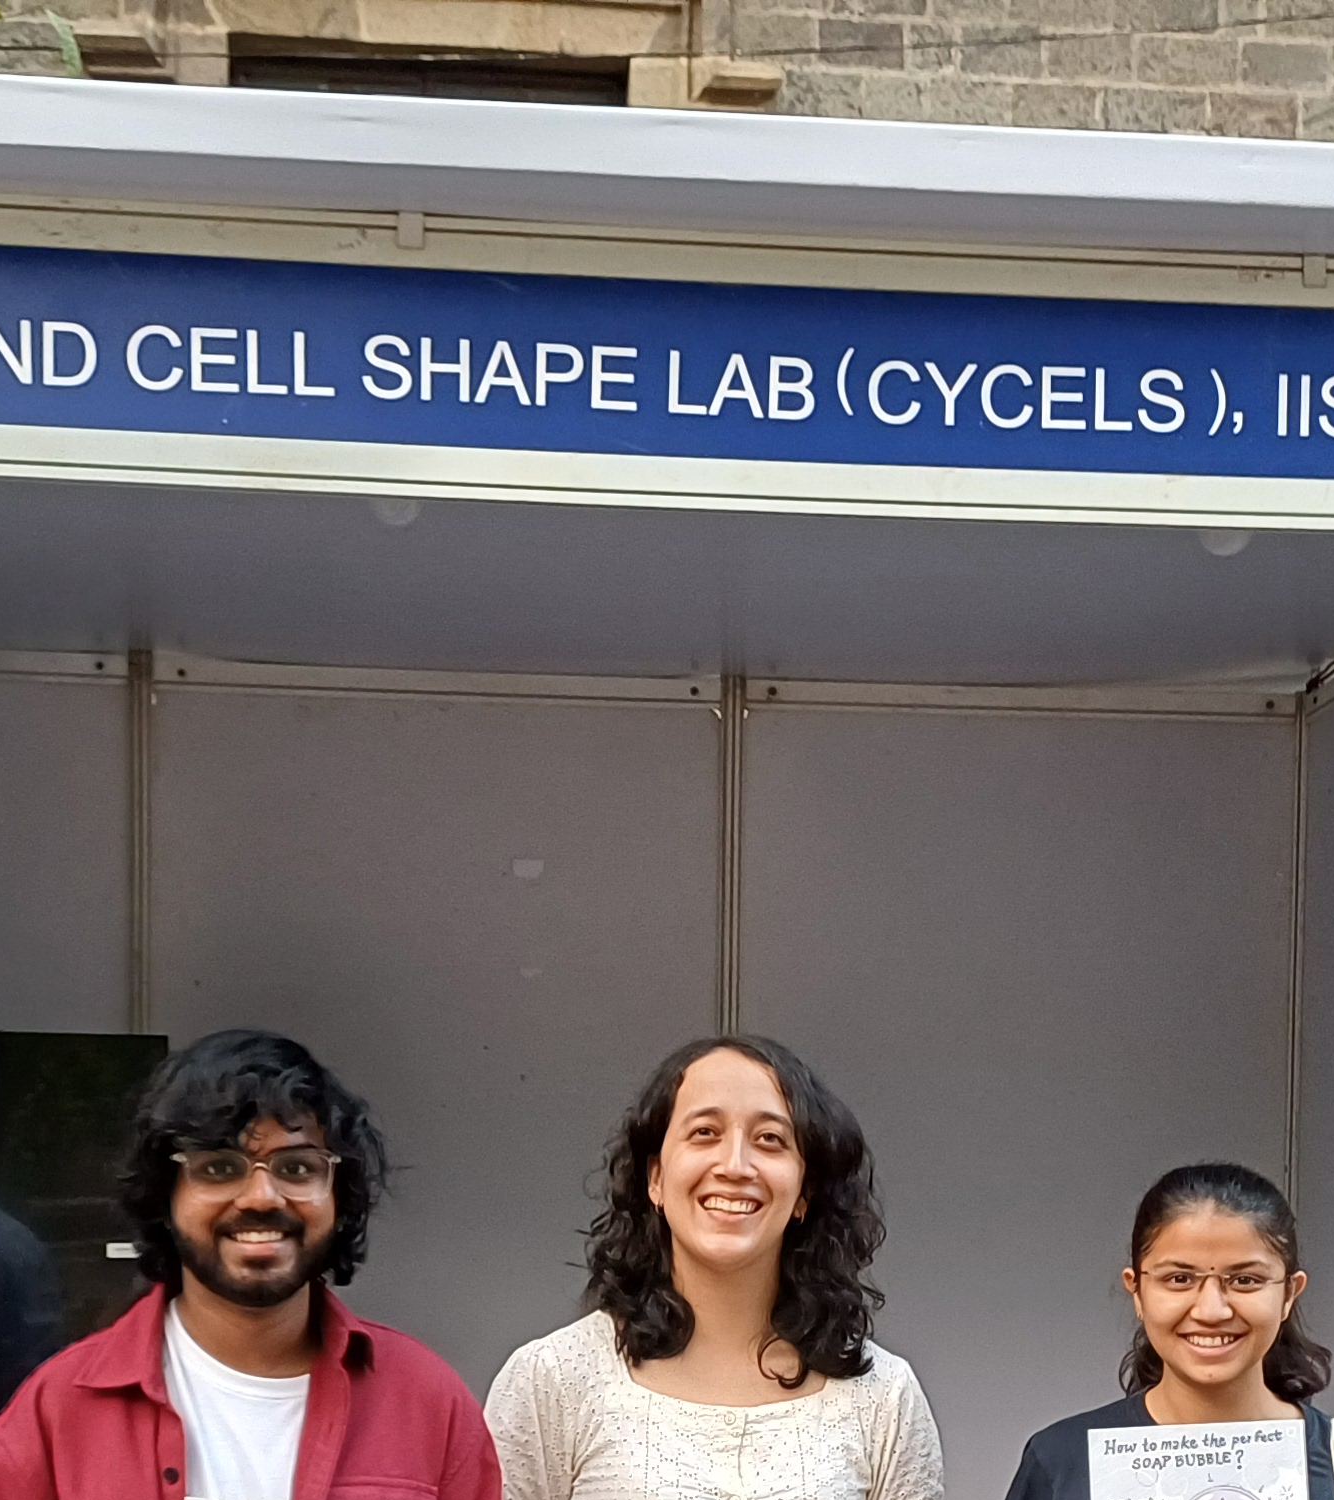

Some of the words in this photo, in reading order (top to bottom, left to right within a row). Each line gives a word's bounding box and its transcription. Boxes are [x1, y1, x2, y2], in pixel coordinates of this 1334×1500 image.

[125, 324, 336, 398] CELL
[362, 334, 638, 412] SHAPE
[667, 349, 814, 422] LAB
[1104, 1439, 1137, 1455] How
[1142, 1438, 1157, 1452] to
[1161, 1435, 1198, 1450] make
[1202, 1433, 1226, 1447] the
[1231, 1430, 1283, 1450] perfect
[1132, 1455, 1171, 1470] SOAP
